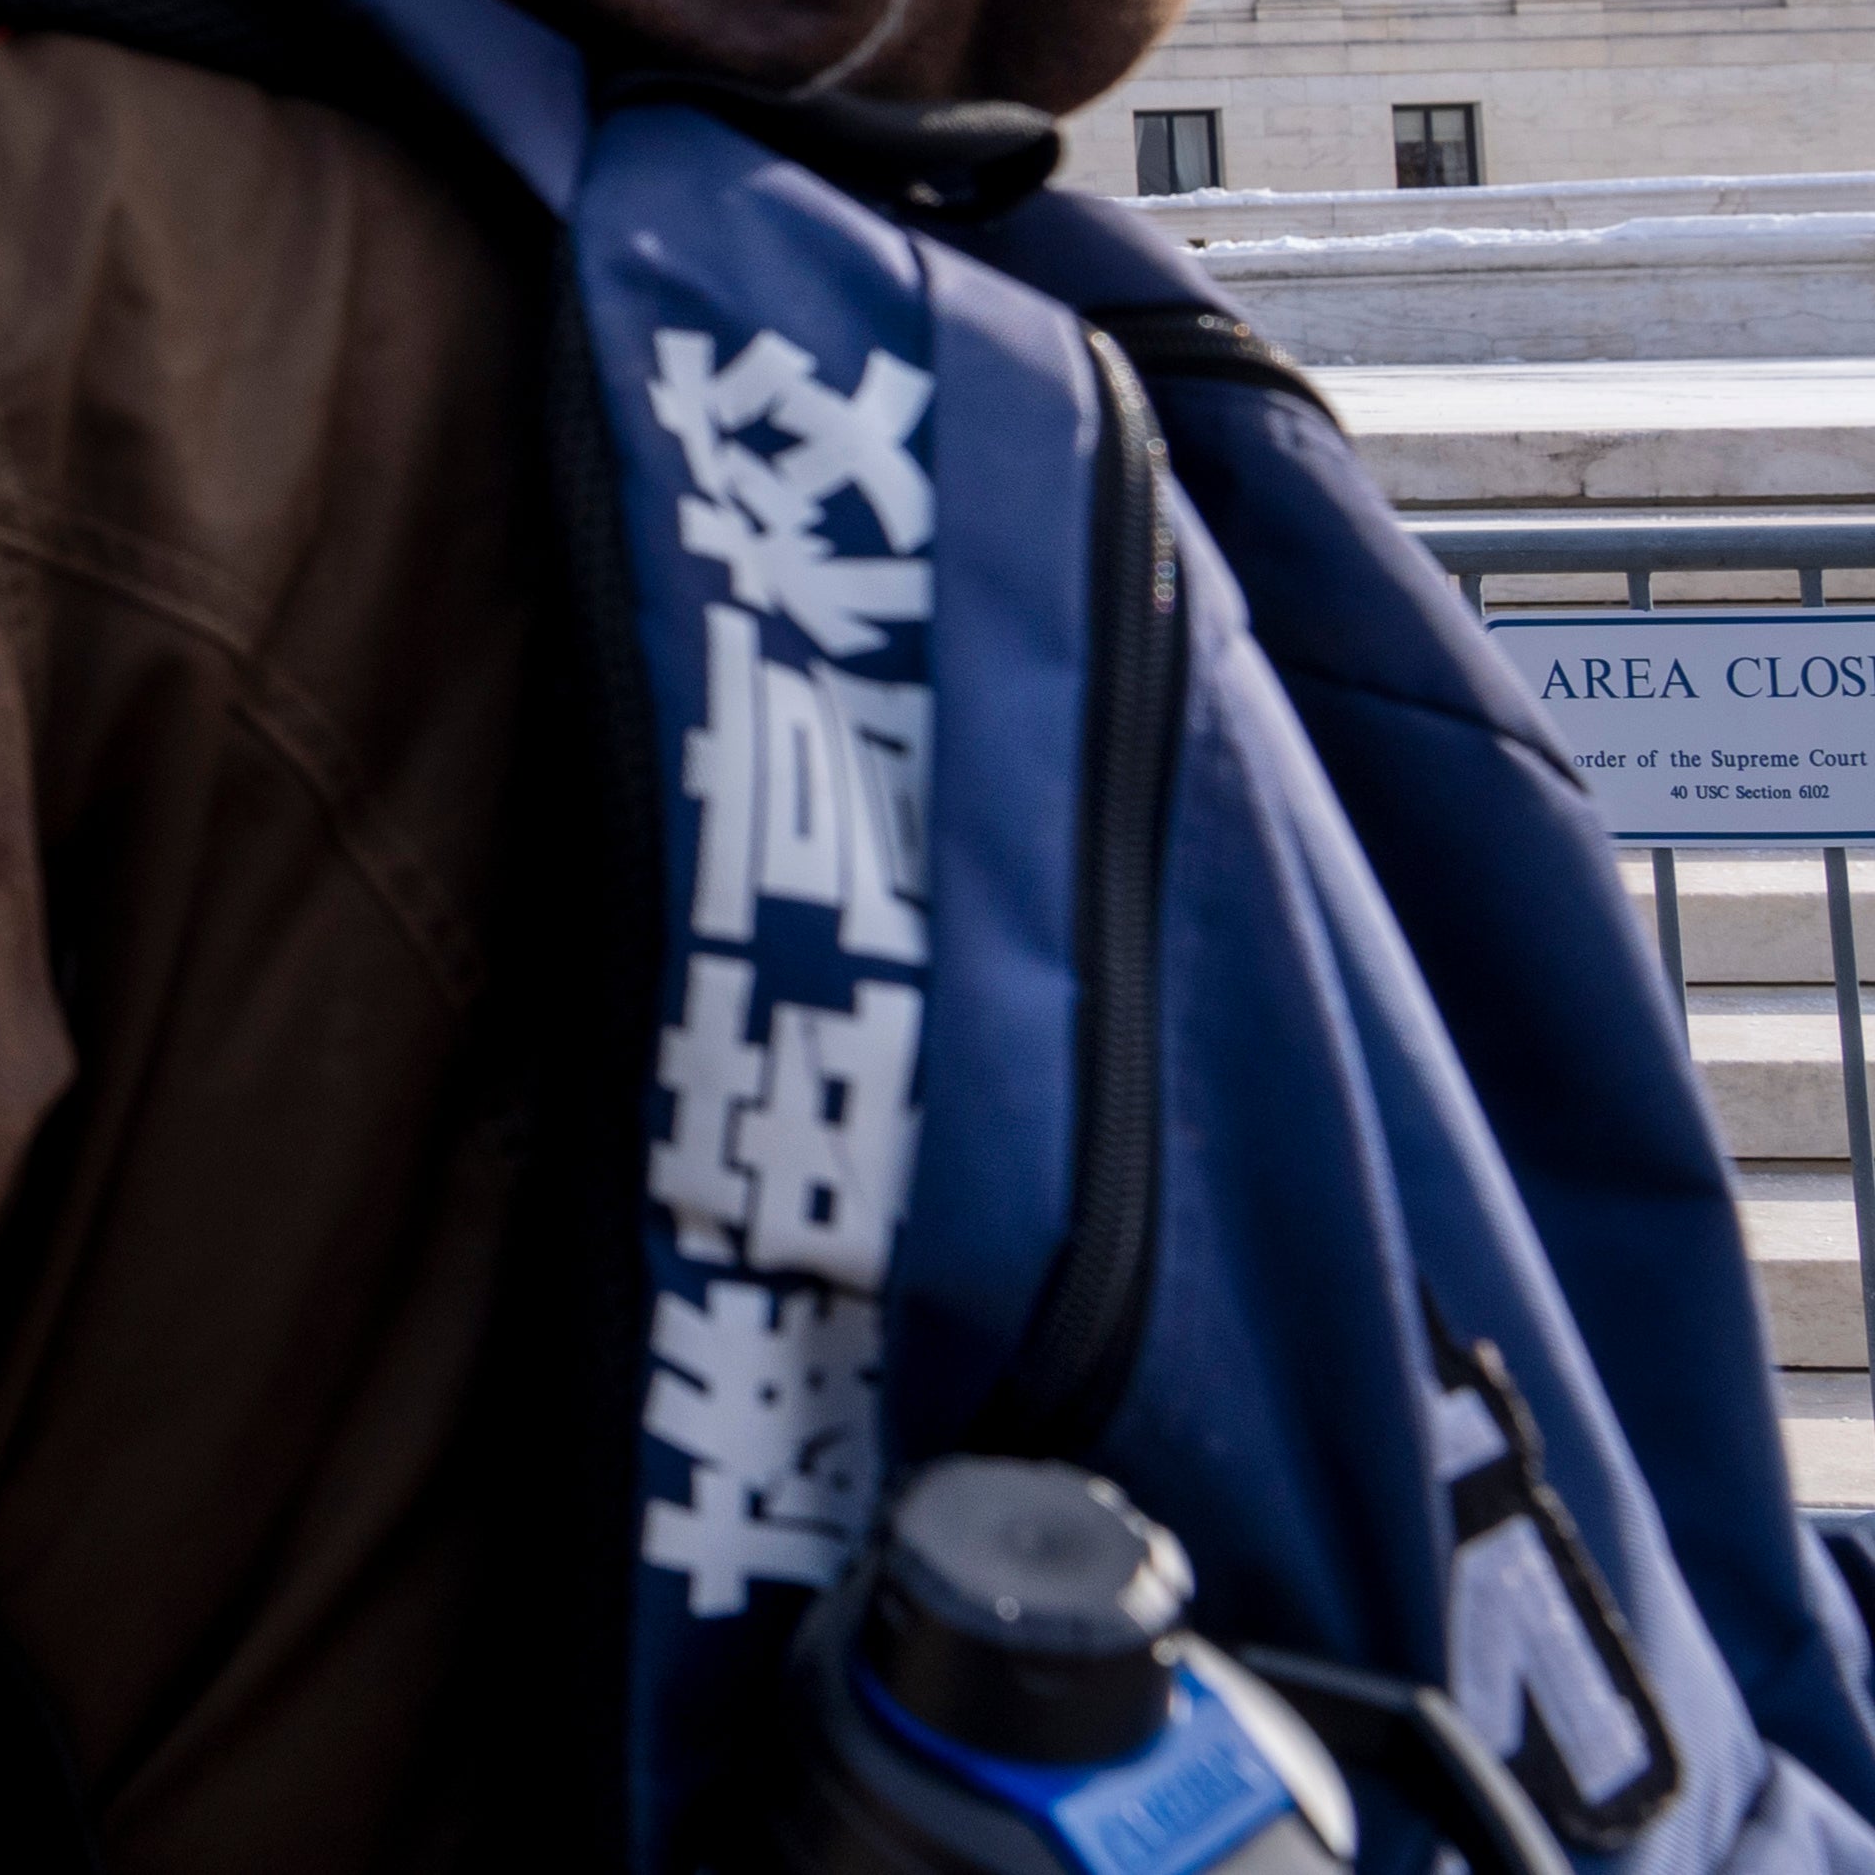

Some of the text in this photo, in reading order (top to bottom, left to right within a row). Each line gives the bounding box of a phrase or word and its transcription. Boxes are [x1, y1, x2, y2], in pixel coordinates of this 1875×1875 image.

[1541, 655, 1875, 699] AREA CLOS
[1573, 749, 1868, 772] order of the Supreme Court
[1669, 784, 1830, 800] 40 USC Section 6102
